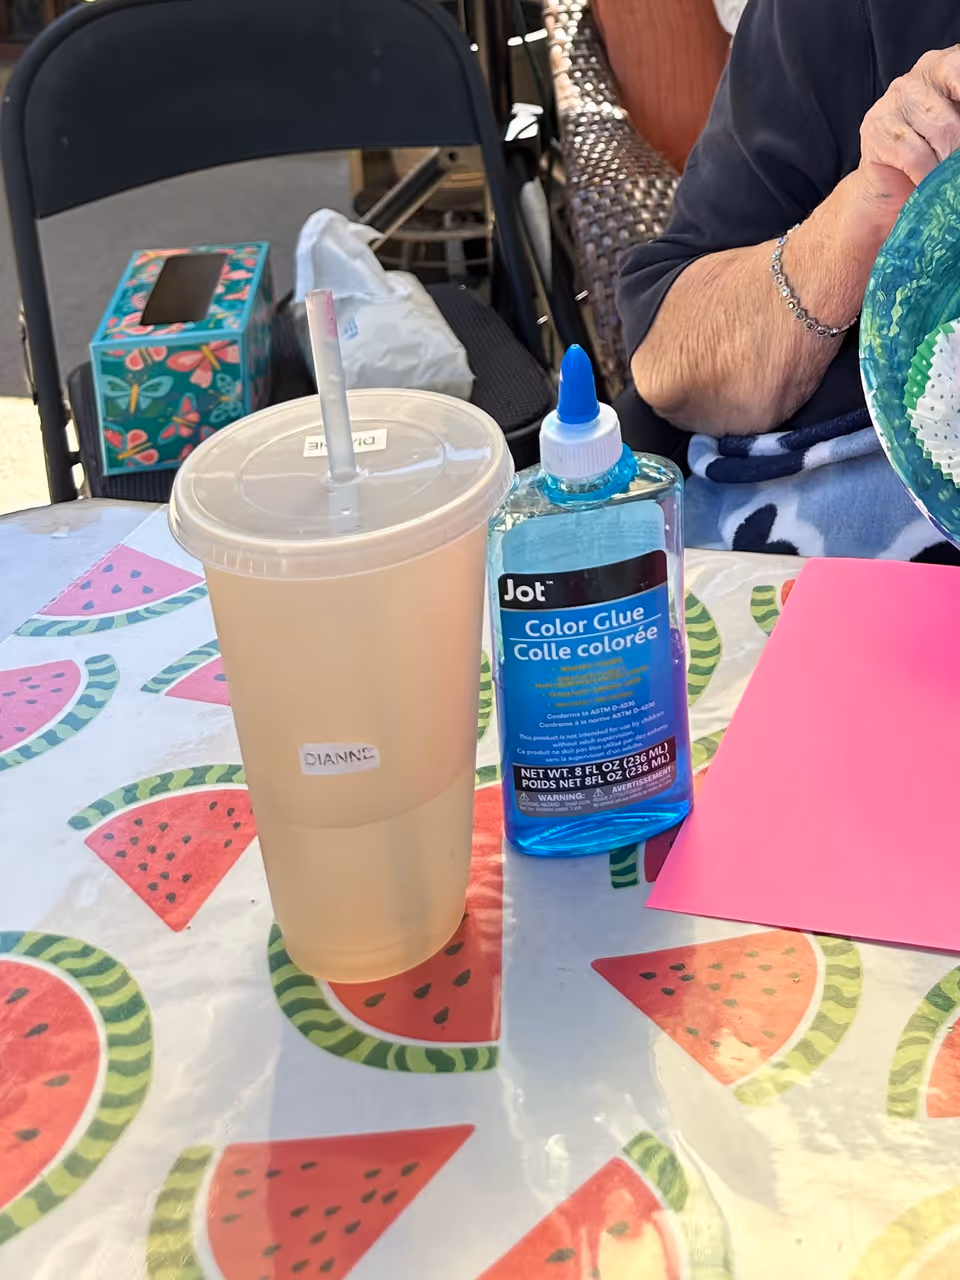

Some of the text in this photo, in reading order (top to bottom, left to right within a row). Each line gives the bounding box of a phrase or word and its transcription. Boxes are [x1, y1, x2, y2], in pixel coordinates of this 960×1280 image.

[524, 606, 645, 637] Color Glue
[513, 625, 658, 661] Colle colorée
[547, 712, 580, 720] Conforms
[590, 706, 610, 715] ASTM
[612, 710, 631, 719] ASTM
[578, 727, 608, 737] intended
[304, 747, 376, 766] DIANNE
[520, 741, 669, 779] NET WT. 8 FL OZ (236 ML)
[521, 779, 556, 789] POIDS
[559, 778, 582, 789] NET
[607, 770, 623, 782] OZ
[625, 764, 649, 779] (236
[651, 752, 671, 768] ML)
[537, 792, 587, 802] WARNING:
